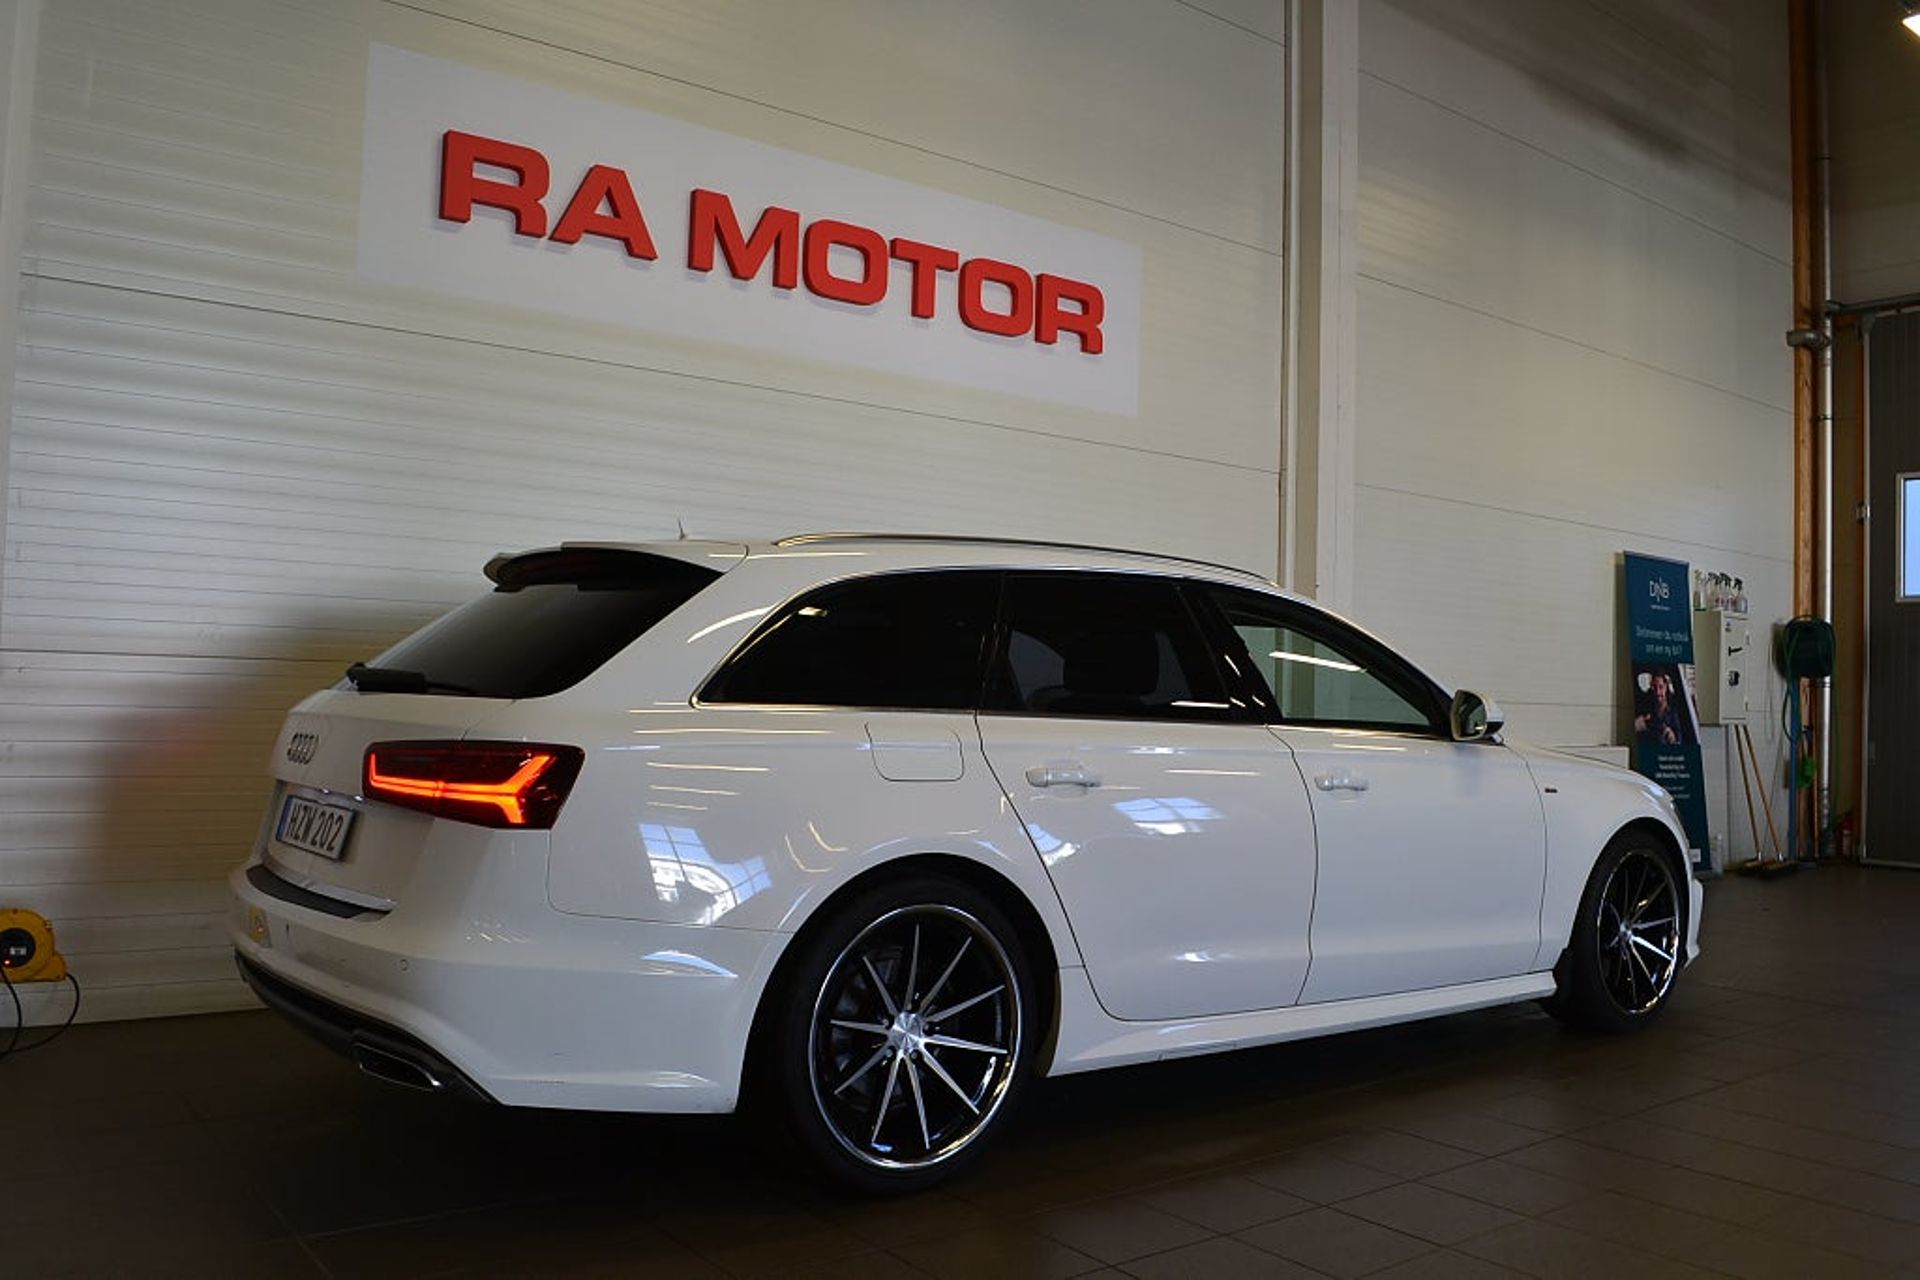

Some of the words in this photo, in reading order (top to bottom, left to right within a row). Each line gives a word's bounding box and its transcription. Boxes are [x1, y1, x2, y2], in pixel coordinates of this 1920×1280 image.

[438, 129, 658, 261] RA
[687, 187, 1105, 355] MOTOR
[1648, 576, 1670, 603] DNB
[310, 810, 344, 852] 202
